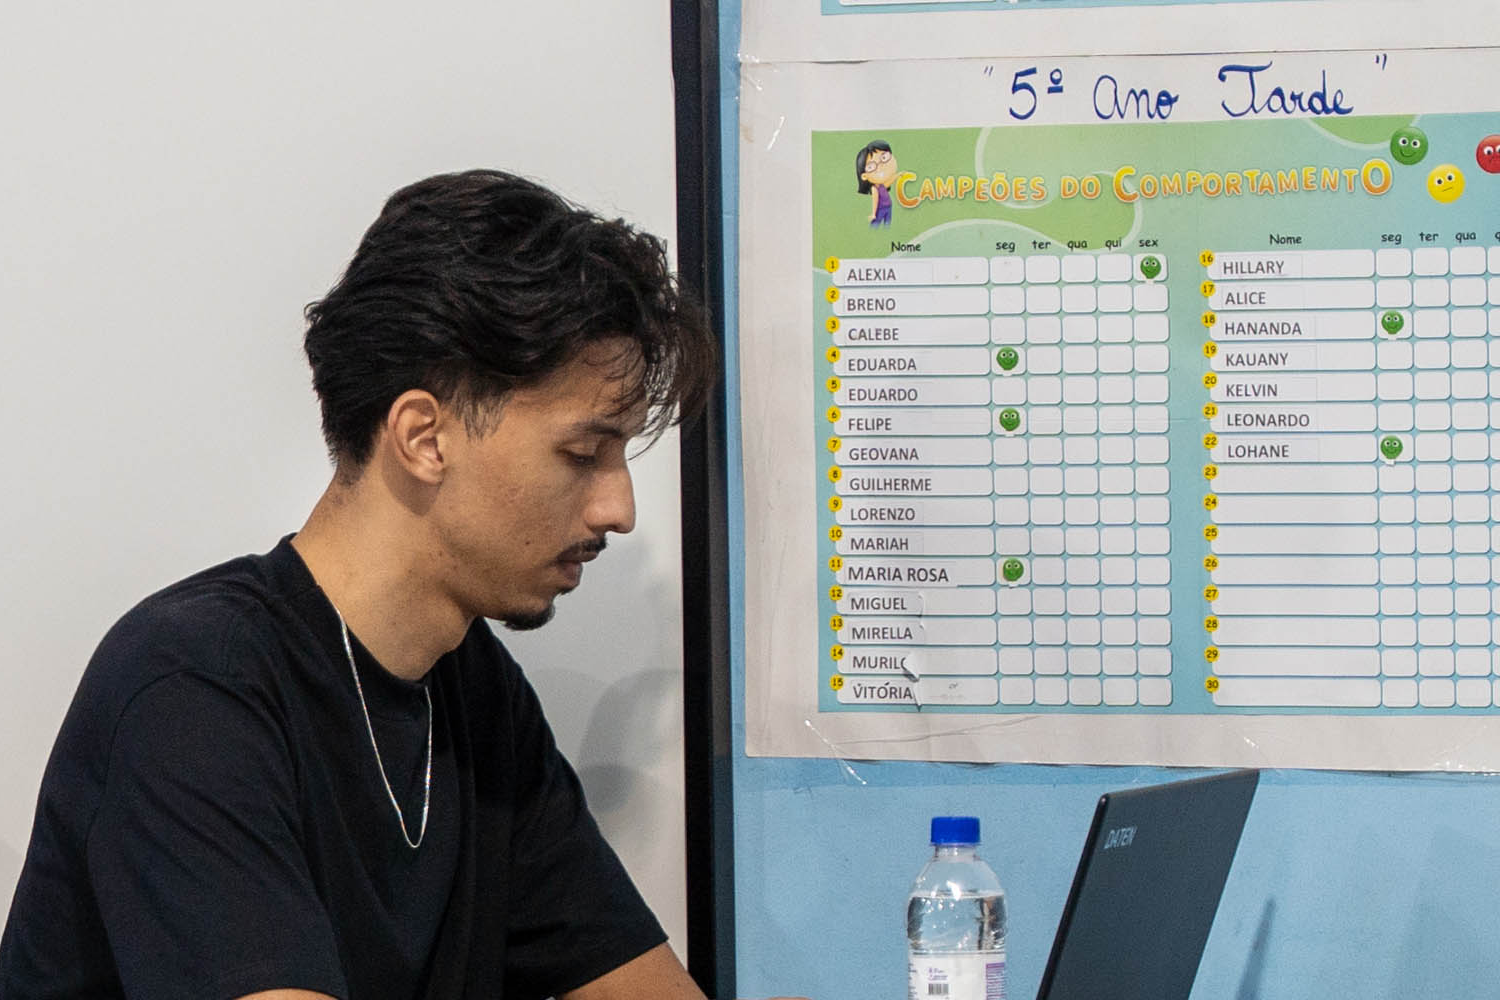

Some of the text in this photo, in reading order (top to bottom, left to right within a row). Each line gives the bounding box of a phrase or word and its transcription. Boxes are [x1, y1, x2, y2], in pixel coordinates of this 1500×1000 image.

[895, 158, 1392, 207] CAMPEÕES DO COMPORTAMENTO
[891, 239, 1159, 253] Nome seg ter qua qui sex
[1269, 231, 1477, 246] Nome seg ter qua
[1202, 254, 1285, 275] 16 HILLARY
[846, 268, 897, 282] ALEXIA
[1203, 284, 1266, 305] 17 ALICE
[847, 297, 896, 312] BRENO
[1204, 314, 1302, 336] 18 HANANDA
[847, 327, 899, 341] CALEBE
[1205, 345, 1289, 367] 19 KAUANY
[848, 357, 917, 372] EDUARDA
[1203, 377, 1278, 397] 20 KELVIN
[848, 388, 918, 402] EDUARDO
[848, 417, 892, 431] FELIPE
[1204, 406, 1310, 427] 21 LEONARDO
[848, 447, 920, 461] GEOVANA
[1204, 436, 1289, 459] 22 LOHANE
[1204, 467, 1217, 477] 23
[849, 477, 932, 492] GUILHERME
[1205, 497, 1217, 507] 24
[850, 507, 916, 521] LORENZO
[1205, 527, 1218, 537] 25
[830, 530, 909, 551] 10 MARIAH
[1205, 558, 1218, 568] 26
[830, 559, 949, 583] 11 MARIA ROSA
[831, 588, 908, 611] 12 MIGUEL
[1205, 589, 1218, 598] 27
[831, 618, 913, 640] 13 MIRELLA
[1205, 619, 1218, 629] 28
[831, 648, 844, 658] 14
[1206, 649, 1219, 659] 29
[832, 677, 914, 700] 15 VITÓRIA
[1206, 680, 1218, 690] 30
